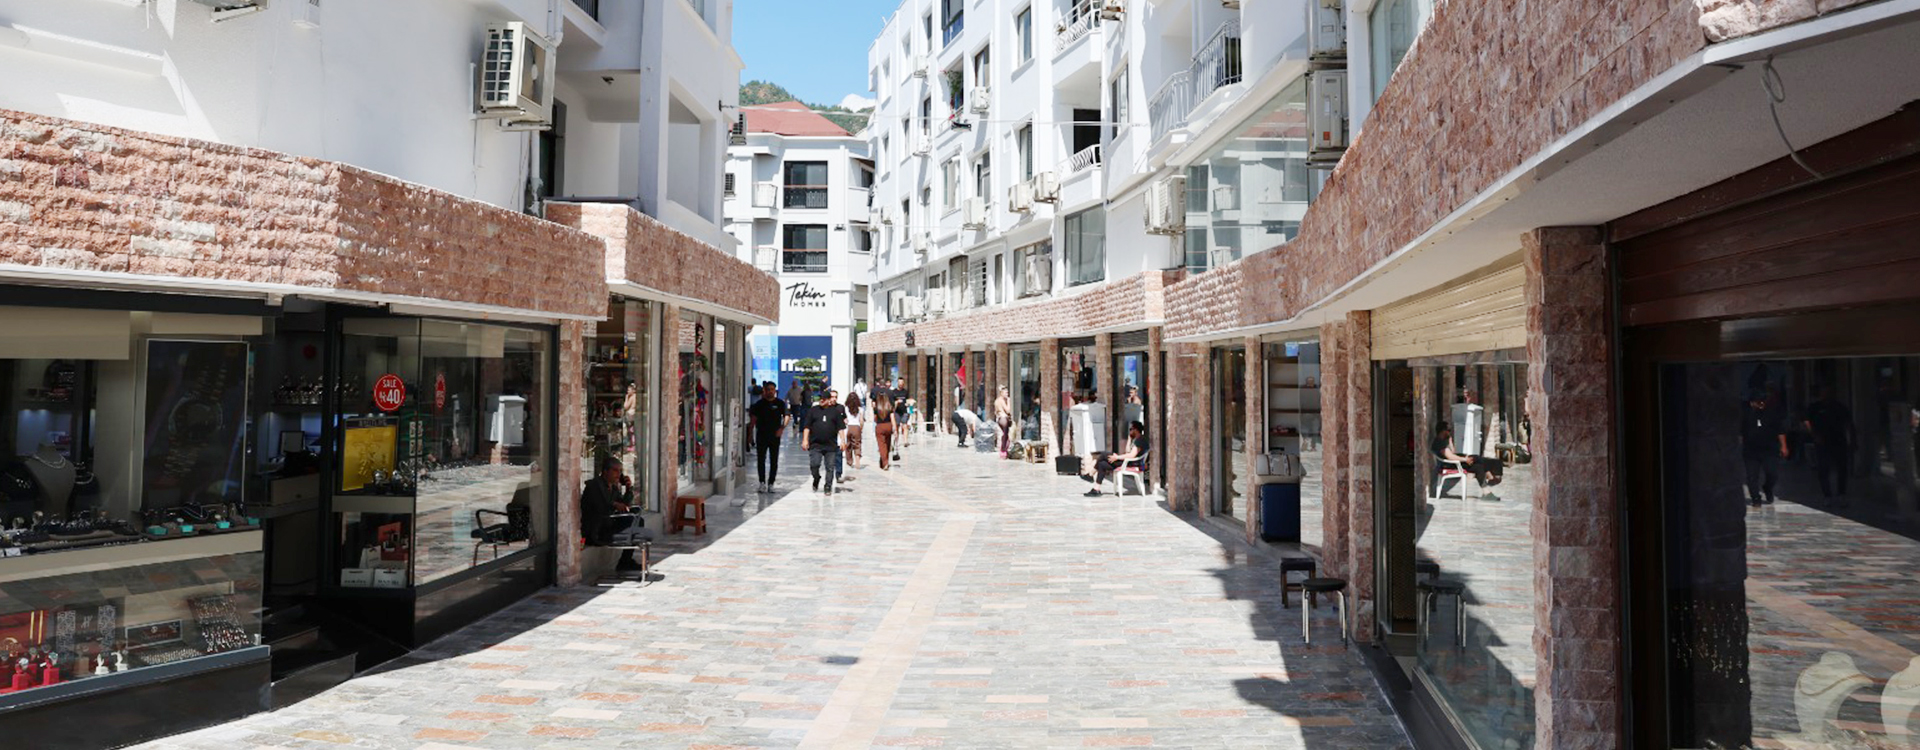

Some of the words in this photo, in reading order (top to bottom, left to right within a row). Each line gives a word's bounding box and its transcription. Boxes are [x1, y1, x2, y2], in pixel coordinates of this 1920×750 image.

[785, 281, 826, 307] Tekin
[780, 355, 828, 372] mi
[383, 379, 397, 388] SALE
